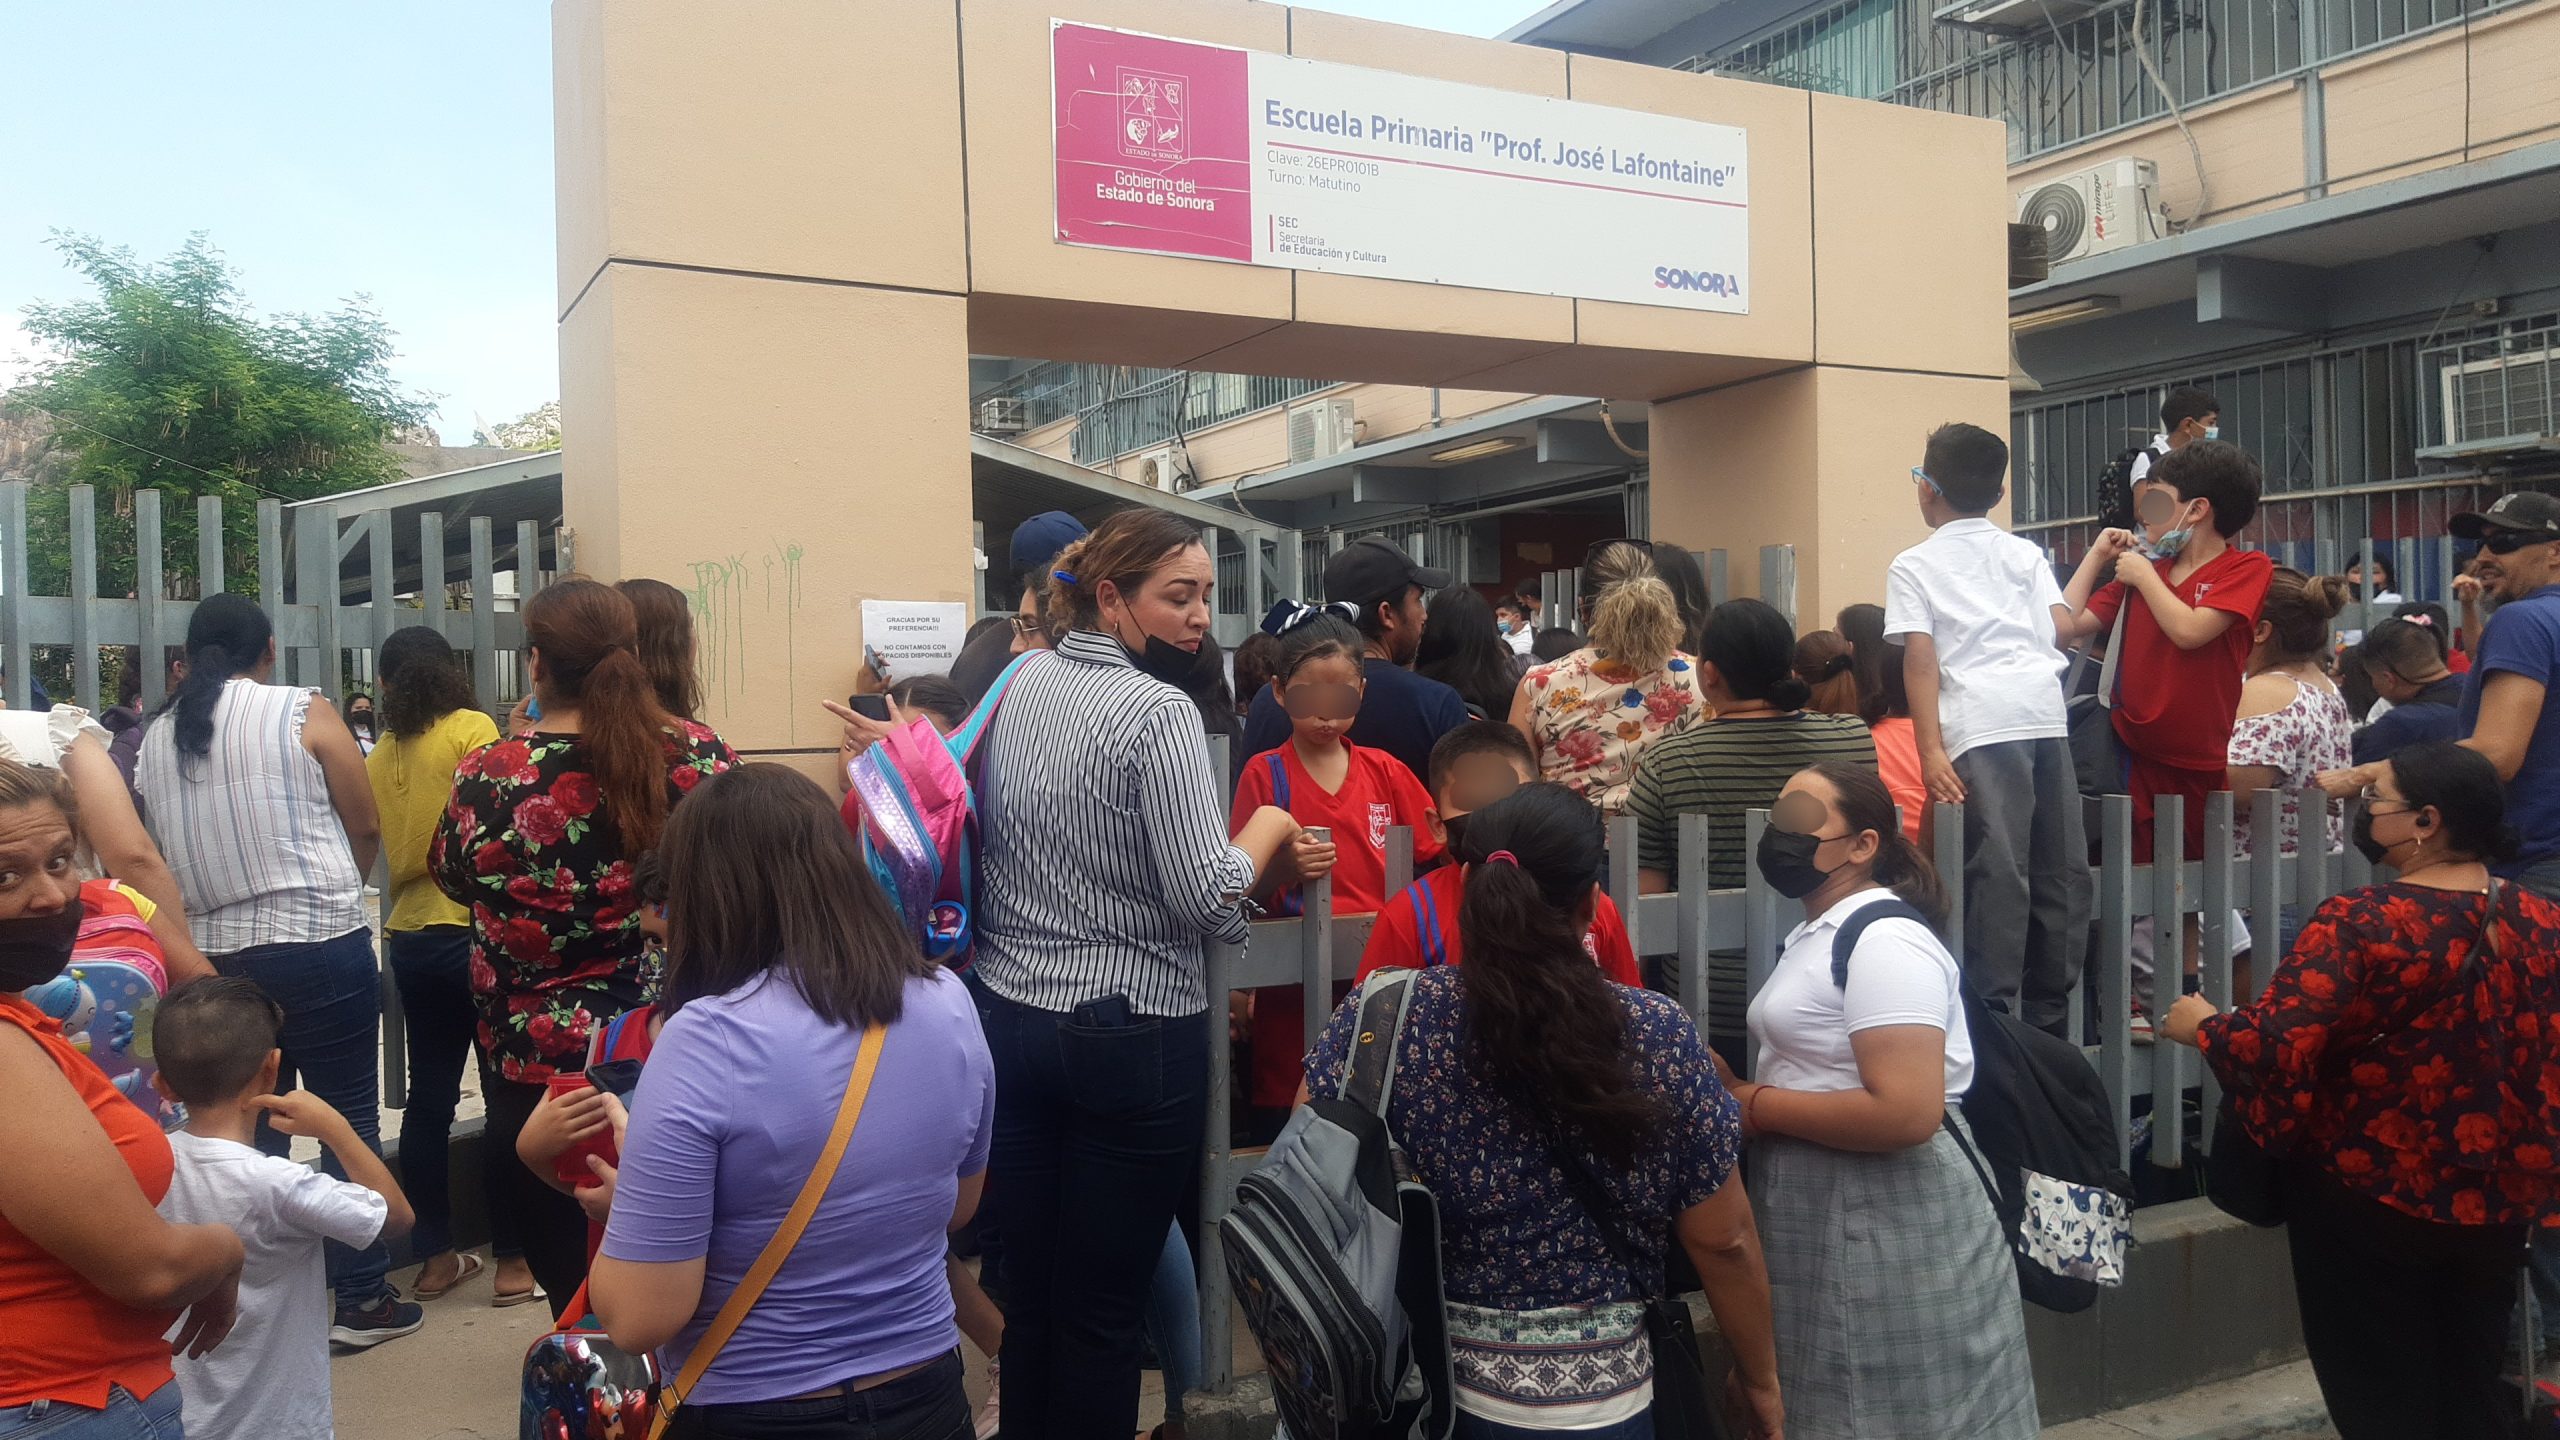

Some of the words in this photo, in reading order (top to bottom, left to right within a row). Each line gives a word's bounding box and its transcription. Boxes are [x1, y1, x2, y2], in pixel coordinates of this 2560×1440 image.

[1125, 147, 1150, 157] ESTADO
[1158, 152, 1183, 161] SONORA
[1265, 99, 1363, 139] Escuela
[1371, 114, 1474, 153] Primaria
[1481, 130, 1546, 164] "Prof.
[1552, 141, 1605, 172] José
[1611, 149, 1736, 188] Lafontaine"
[1267, 150, 1303, 168] Clave:
[1307, 155, 1380, 177] 26EPR0101B
[1115, 170, 1173, 192] Gobierno
[1176, 178, 1196, 194] del
[1268, 169, 1305, 186] Turno:
[1309, 174, 1361, 193] Matutino
[1096, 183, 1144, 204] Estado
[1146, 190, 1164, 205] de
[1166, 192, 1215, 212] Sonora
[2093, 173, 2102, 216] mirage
[1278, 216, 1298, 229] SEC
[1279, 242, 1291, 253] de
[1294, 243, 1343, 259] Educación
[1344, 250, 1351, 263] y
[1352, 250, 1387, 263] Cultura
[1654, 266, 1740, 298] SONORA
